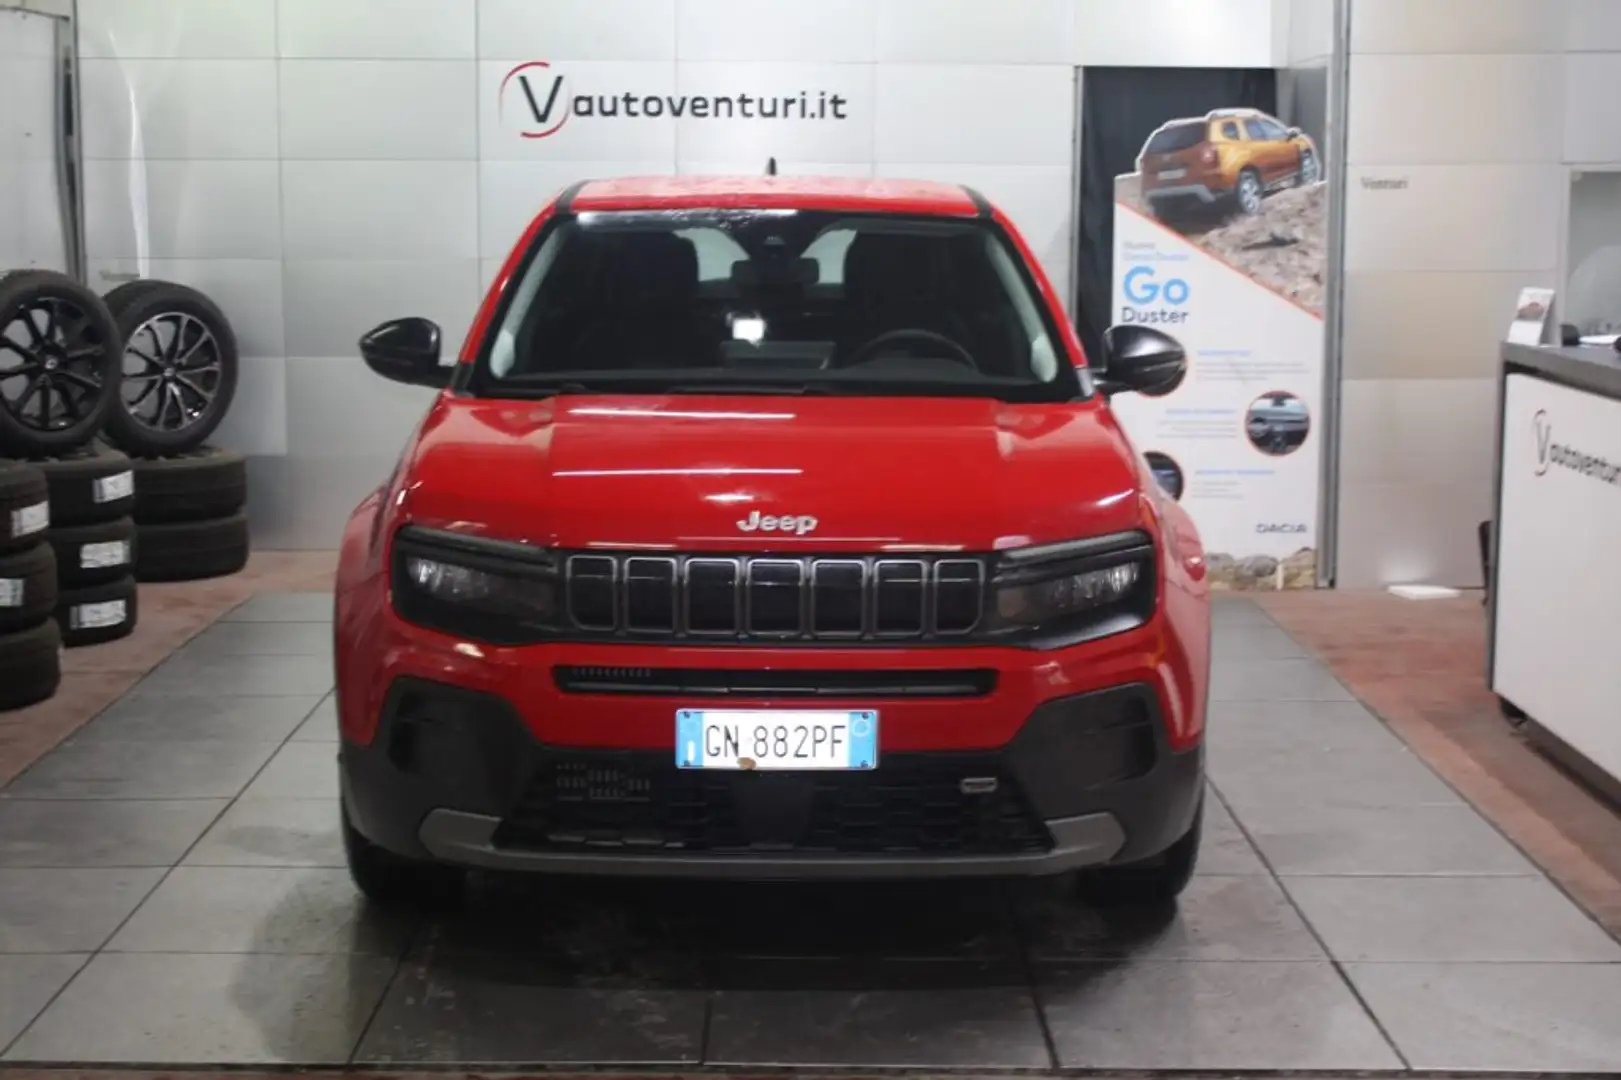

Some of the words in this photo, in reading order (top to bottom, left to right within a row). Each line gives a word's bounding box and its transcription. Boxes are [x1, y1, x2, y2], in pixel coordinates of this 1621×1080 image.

[572, 91, 848, 120] autoventuri.it
[1123, 265, 1190, 306] Go
[1122, 306, 1189, 324] Duster
[735, 509, 818, 535] Jeep
[705, 725, 740, 758] GN
[753, 725, 846, 758] 882PF
